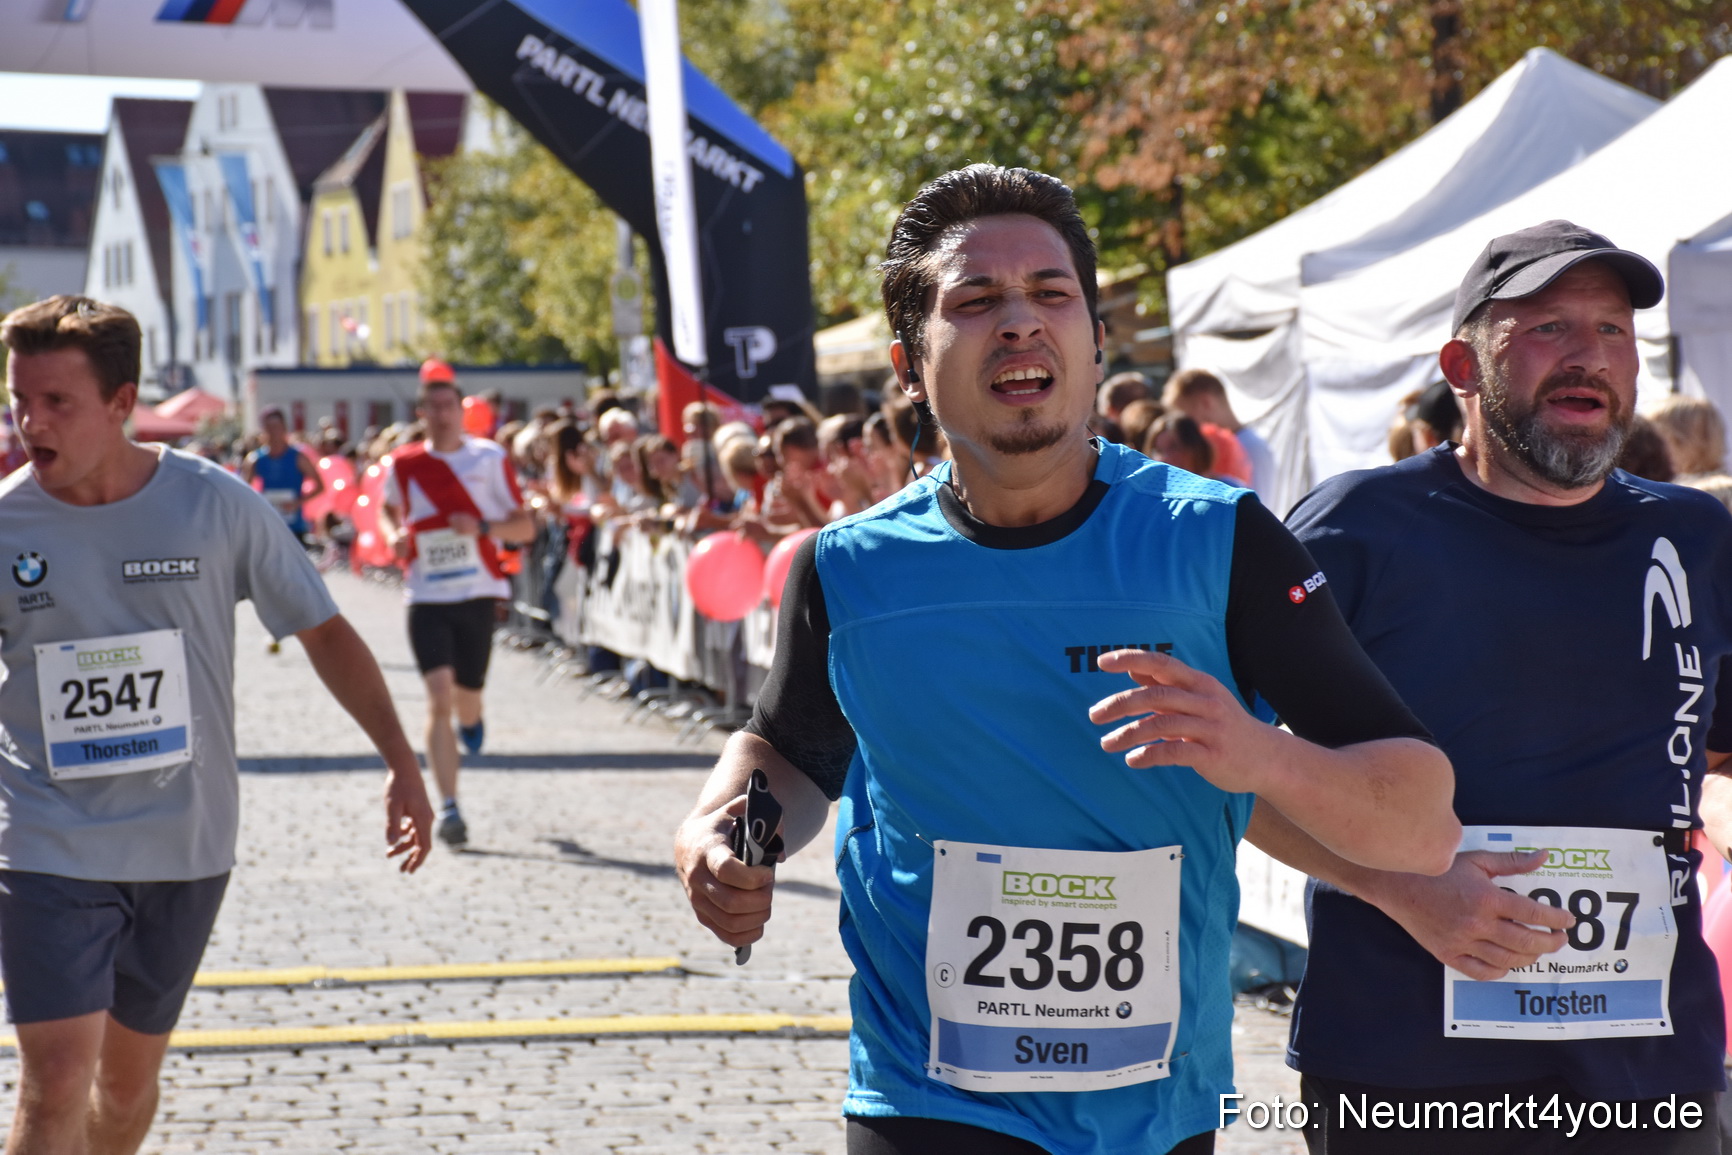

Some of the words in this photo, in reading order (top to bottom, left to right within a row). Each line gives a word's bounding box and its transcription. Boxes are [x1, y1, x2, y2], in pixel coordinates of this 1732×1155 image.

[516, 34, 607, 107] PARTL
[122, 558, 199, 577] BOCK
[77, 646, 142, 667] BOCK
[61, 669, 163, 719] 2547
[74, 721, 104, 734] PARTL
[106, 719, 149, 731] Neumarkt
[81, 738, 159, 761] Thorsten
[1515, 847, 1613, 871] OCK
[1002, 871, 1117, 900] BOCK
[1001, 897, 1036, 907] inspired
[1038, 899, 1048, 909] by
[1050, 900, 1077, 909] smart
[1078, 902, 1118, 911] concepts
[963, 915, 1144, 992] 2358
[1548, 961, 1610, 974] Neumarkt
[978, 1000, 1031, 1016] PARTL
[1036, 1003, 1109, 1018] Neumarkt
[1514, 989, 1608, 1017] Torsten
[1014, 1034, 1089, 1065] Sven
